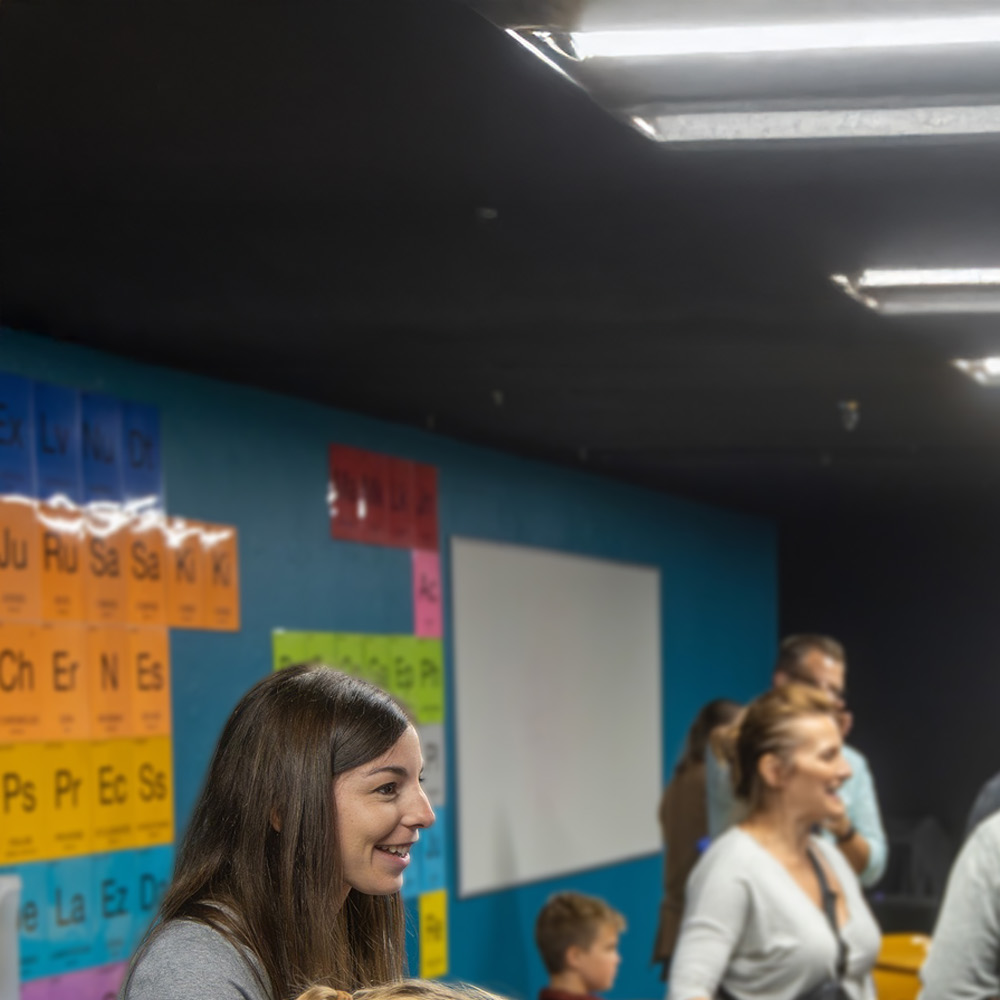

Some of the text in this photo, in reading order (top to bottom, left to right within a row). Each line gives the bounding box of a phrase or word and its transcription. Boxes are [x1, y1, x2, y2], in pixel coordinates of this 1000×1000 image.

[44, 531, 78, 574] Ru
[90, 535, 119, 578] Sa
[131, 542, 160, 582] Sa
[0, 649, 34, 692] Ch
[53, 651, 79, 692] Er
[100, 652, 119, 691] N
[136, 652, 163, 691] Es
[3, 772, 37, 814] Ps
[54, 769, 82, 810] Pr
[98, 765, 128, 806] Ec
[138, 762, 167, 802] Ss
[17, 899, 39, 933] e
[56, 888, 86, 927] La
[101, 878, 128, 918] Ez
